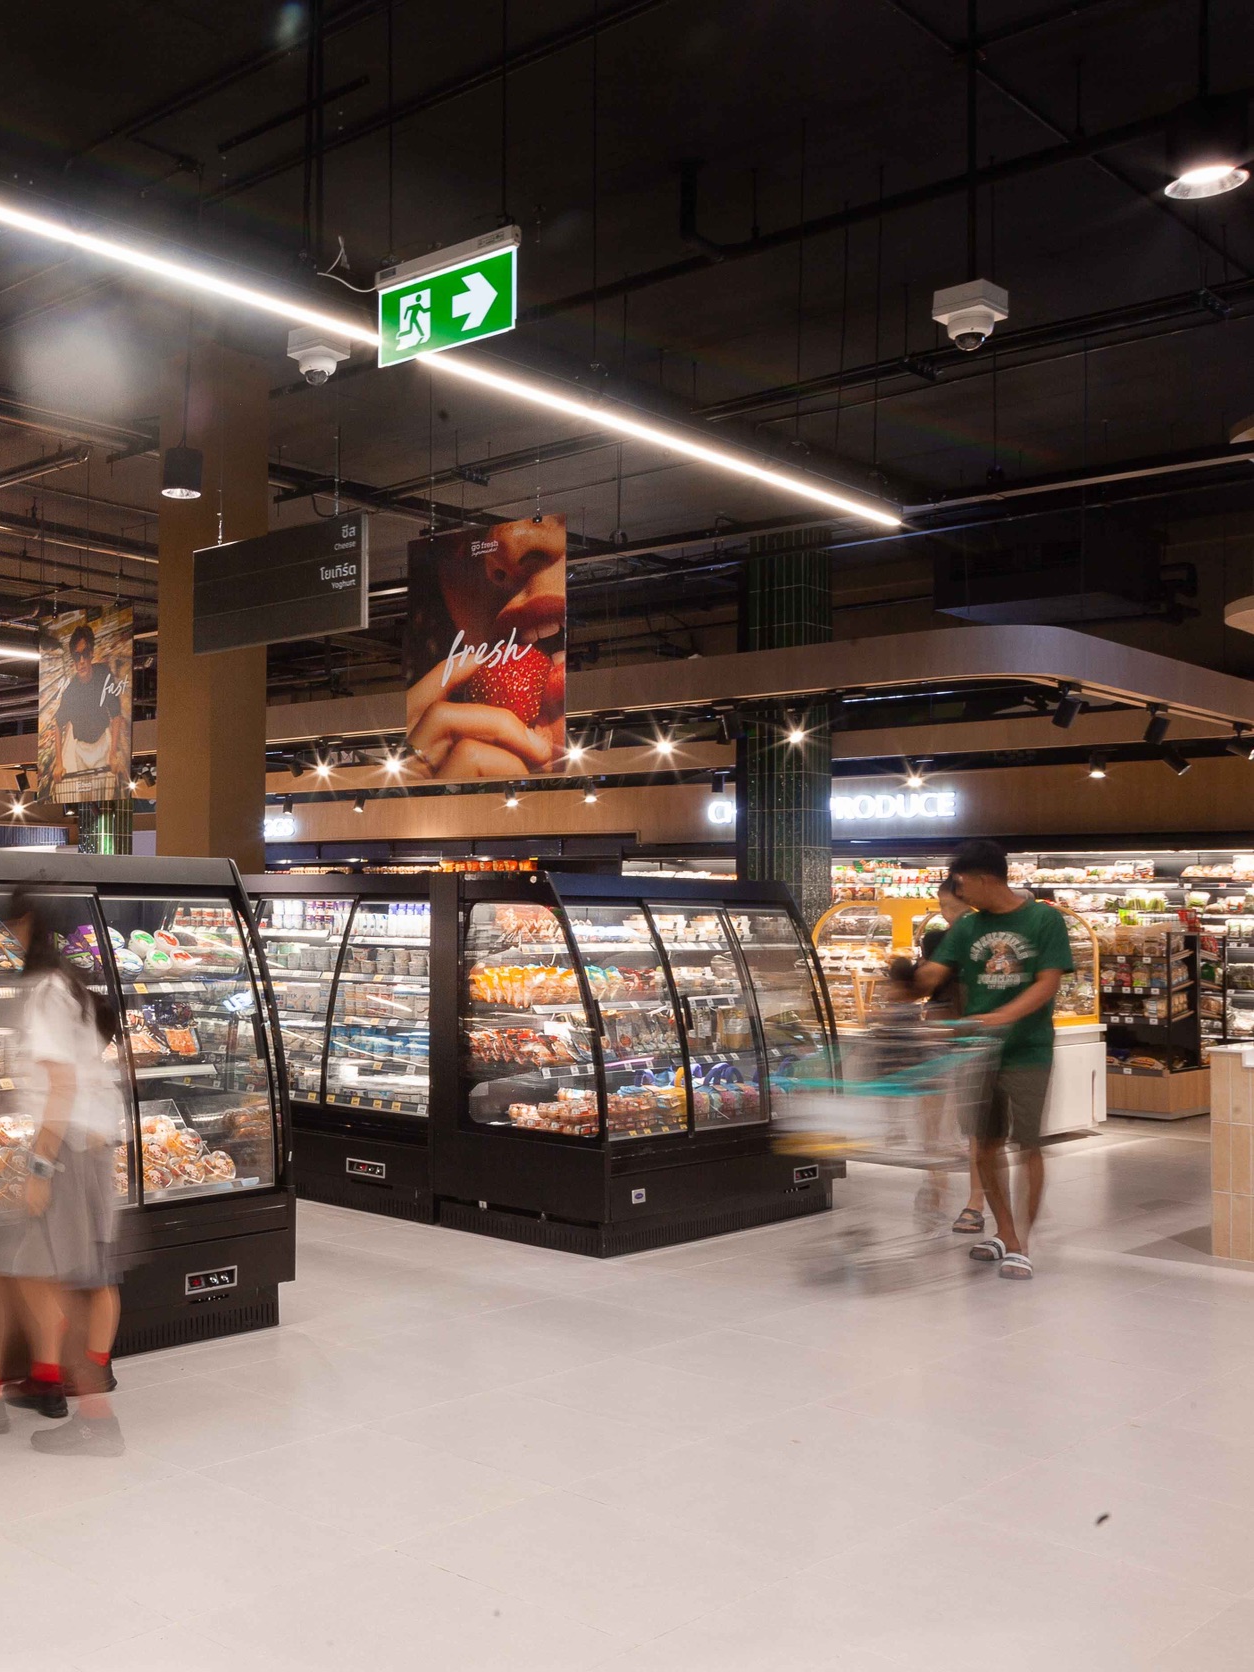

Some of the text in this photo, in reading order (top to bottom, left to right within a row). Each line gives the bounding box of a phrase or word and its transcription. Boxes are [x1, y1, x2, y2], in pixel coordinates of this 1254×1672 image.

[341, 524, 356, 539] ชีส
[334, 541, 356, 551] Cheese
[320, 562, 357, 581] โยเกิร์ต
[331, 579, 357, 590] Yoghurt
[440, 626, 534, 688] fresh
[99, 673, 130, 708] fast
